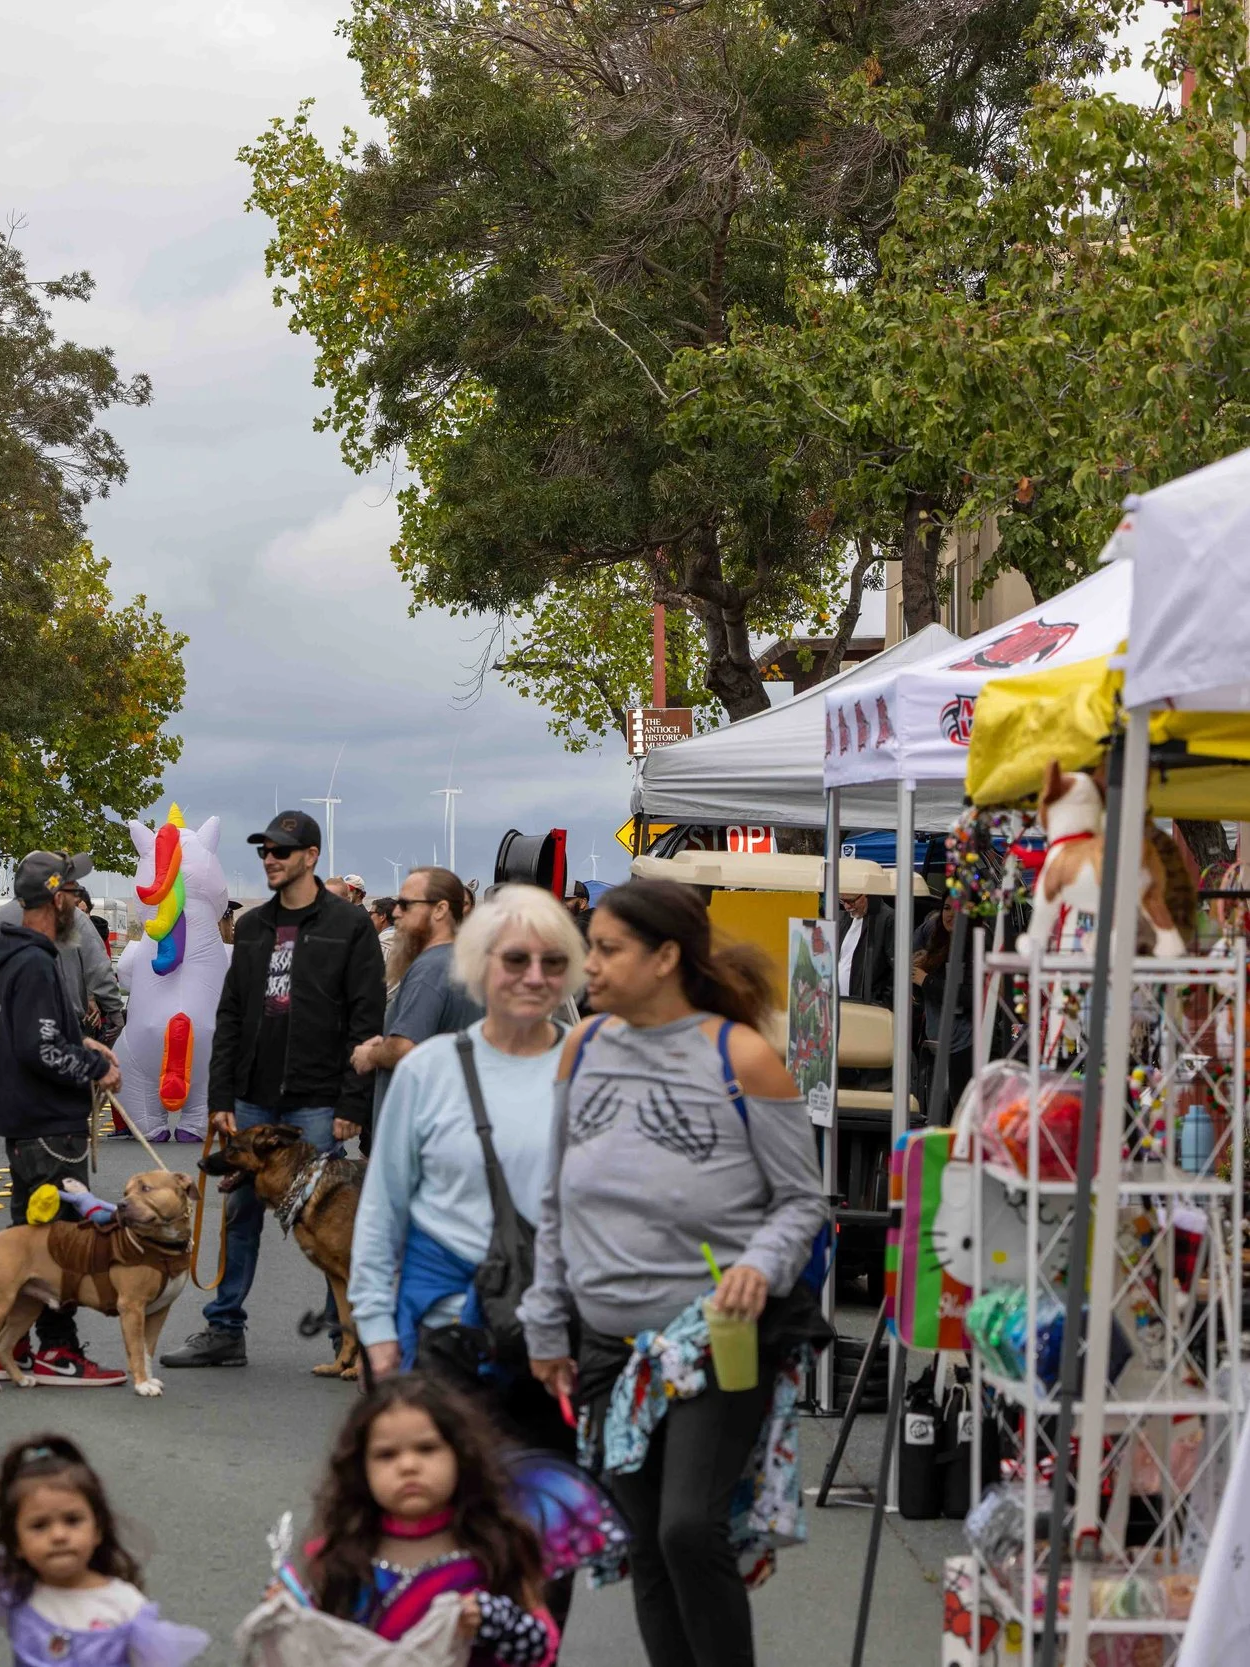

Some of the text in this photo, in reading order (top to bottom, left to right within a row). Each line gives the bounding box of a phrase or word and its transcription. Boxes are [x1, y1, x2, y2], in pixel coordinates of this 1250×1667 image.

[644, 718, 661, 726] THE
[644, 726, 680, 734] ANTIOCH
[688, 825, 767, 853] STOP
